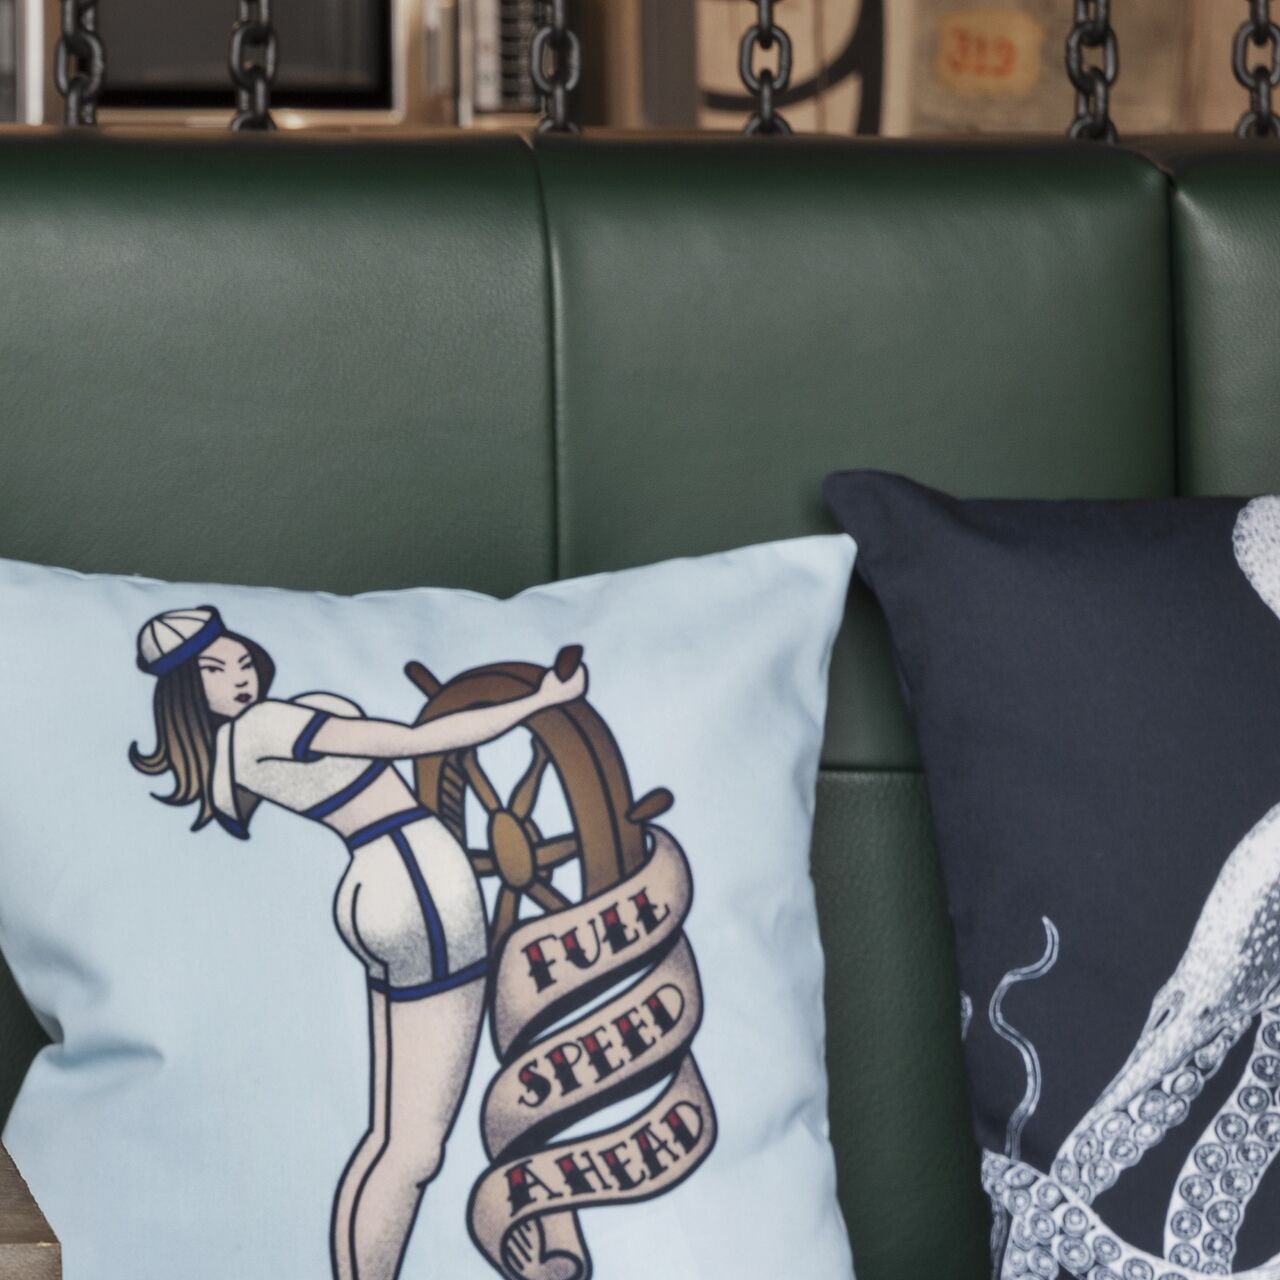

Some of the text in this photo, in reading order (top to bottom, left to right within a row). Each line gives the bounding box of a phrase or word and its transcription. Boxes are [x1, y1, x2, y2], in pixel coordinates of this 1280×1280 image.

[521, 886, 670, 994] FULL
[517, 982, 686, 1108] SPEED
[503, 1100, 704, 1217] AHEAD
